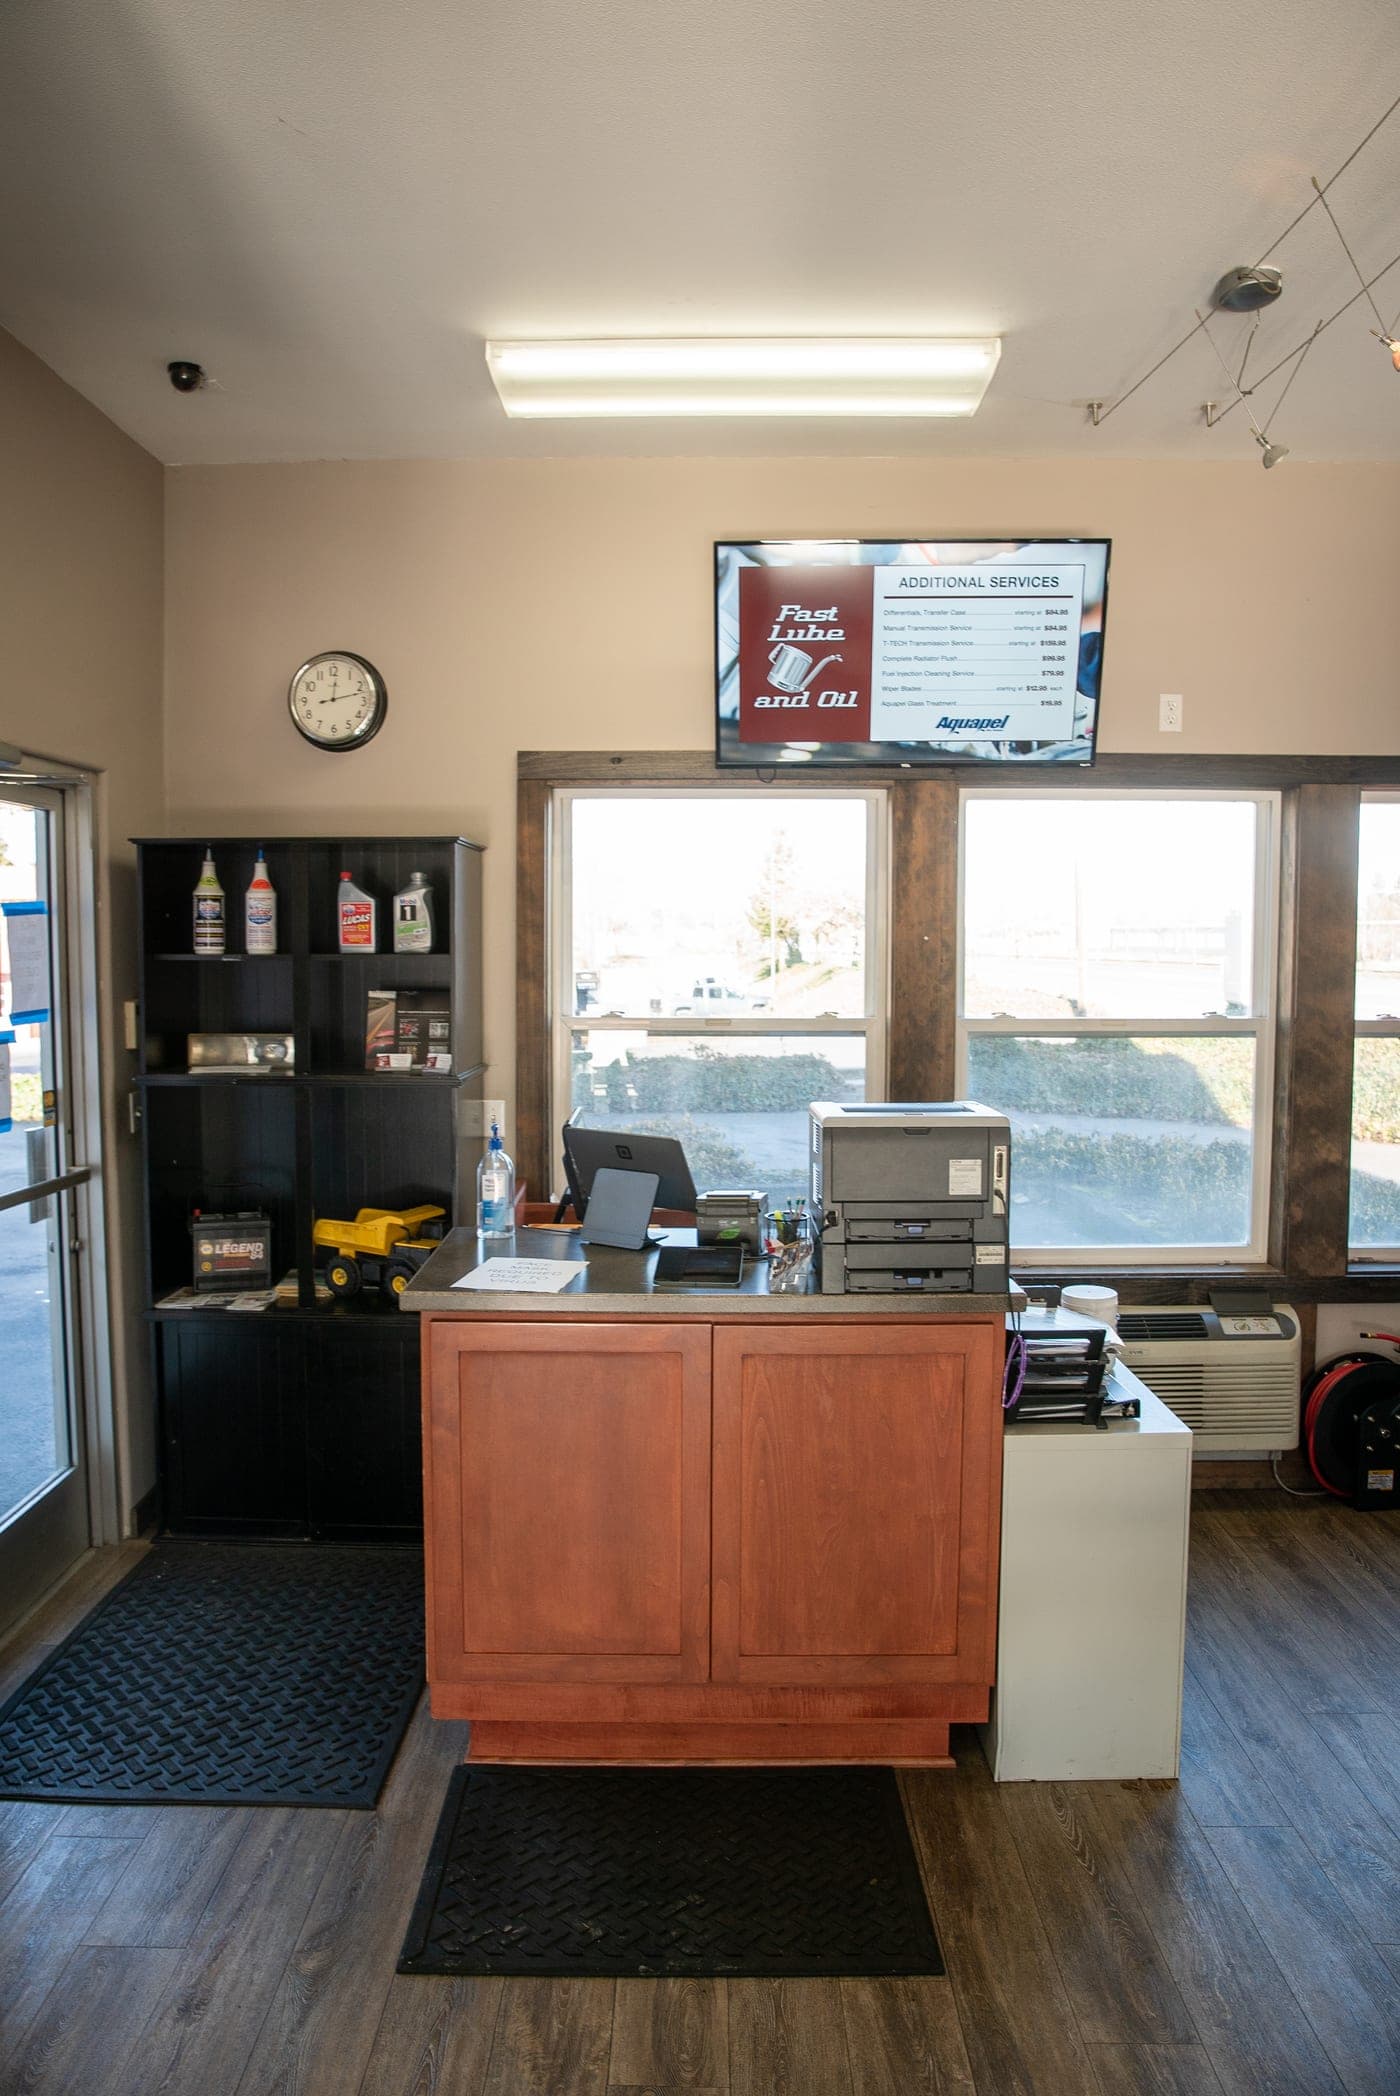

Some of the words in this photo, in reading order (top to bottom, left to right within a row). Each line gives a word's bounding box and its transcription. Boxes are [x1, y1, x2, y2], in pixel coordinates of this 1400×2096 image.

[898, 576, 985, 589] ADDITIONAL
[989, 576, 1060, 589] SERVICES
[775, 604, 839, 622] Fast
[1014, 609, 1035, 617] starting
[767, 624, 846, 641] Lube
[1013, 625, 1034, 633] starting
[1008, 640, 1030, 648] starting
[881, 655, 913, 663] Complete
[316, 670, 325, 681] 11
[328, 665, 339, 677] 12
[896, 670, 923, 678] Injection
[923, 670, 951, 678] Cleaning
[305, 681, 316, 692] 10
[357, 681, 364, 692] 2
[300, 696, 308, 706] 9
[360, 696, 367, 707] 3
[753, 691, 811, 708] and
[817, 690, 859, 708] Oil
[305, 709, 313, 720] 8
[355, 709, 362, 719] 4
[316, 719, 323, 729] 7
[330, 724, 338, 734] 6
[345, 719, 352, 730] 5
[935, 714, 1011, 734] Aquapel
[342, 913, 372, 925] LUCAS
[404, 906, 411, 921] 1
[215, 1242, 264, 1254] LEGEND
